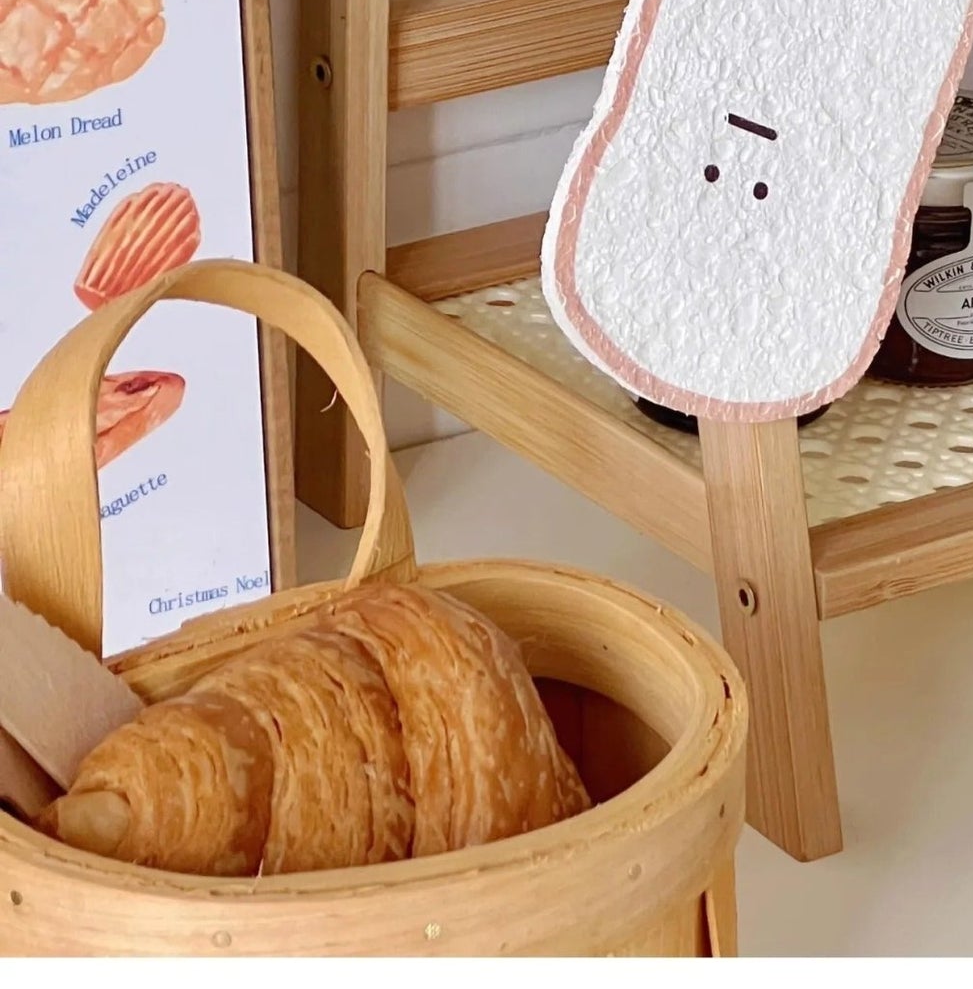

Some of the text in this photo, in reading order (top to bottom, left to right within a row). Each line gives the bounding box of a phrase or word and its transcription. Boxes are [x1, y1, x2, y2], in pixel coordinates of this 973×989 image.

[8, 108, 123, 148] Melon Dread
[70, 149, 158, 229] Madeleine
[923, 264, 965, 289] WILKIN
[923, 321, 963, 344] TIPTREE
[100, 473, 168, 518] aguette
[148, 570, 269, 615] Christmas Noel
